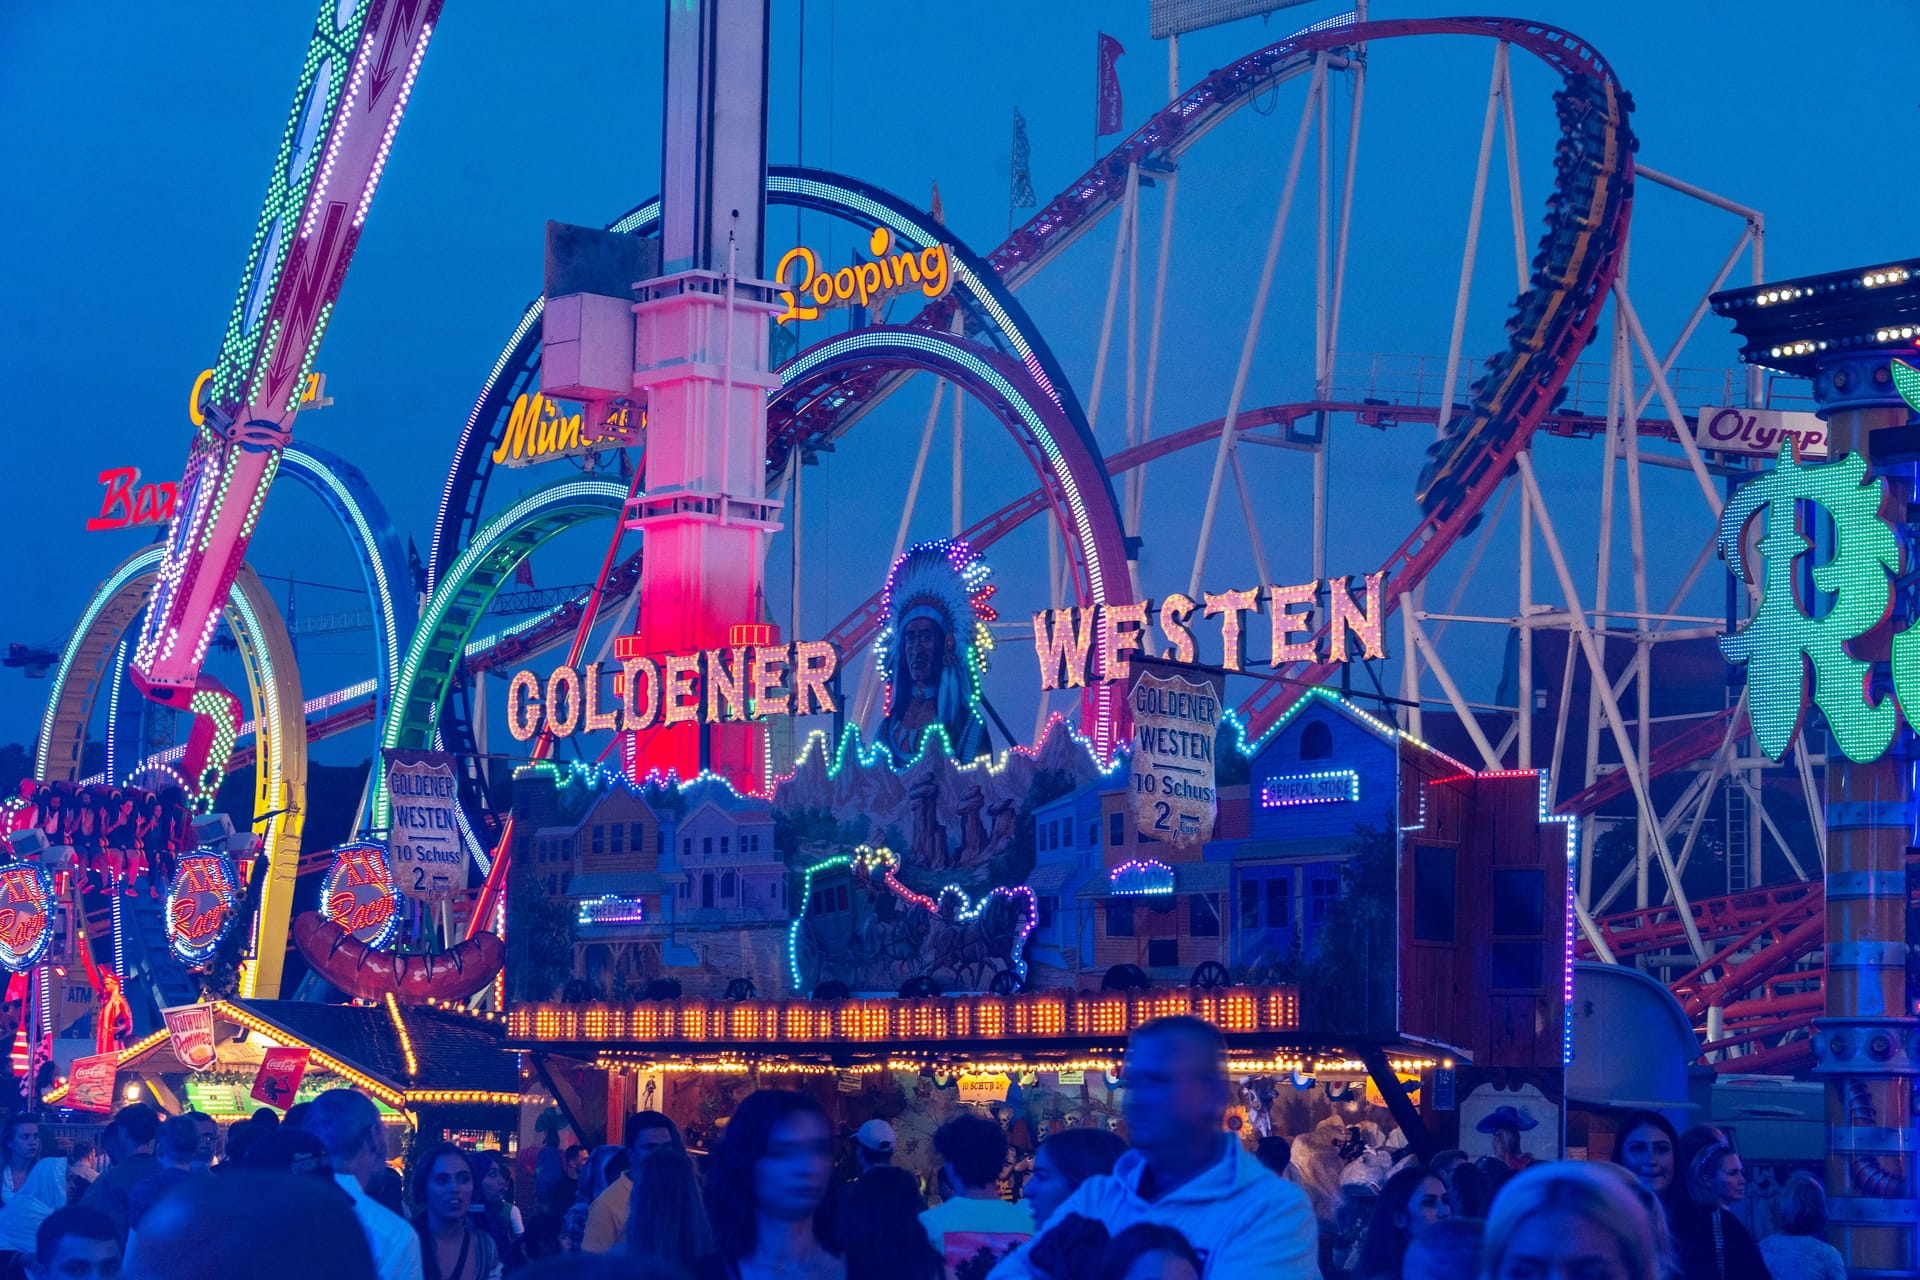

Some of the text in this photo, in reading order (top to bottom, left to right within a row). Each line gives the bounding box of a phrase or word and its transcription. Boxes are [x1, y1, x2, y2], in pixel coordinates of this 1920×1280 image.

[776, 227, 948, 325] Looping
[508, 571, 1392, 741] GOLDENER WESTEN
[1136, 685, 1216, 728] GOLDENER
[1140, 726, 1211, 764] WESTEN
[391, 773, 454, 799] GOLDENER
[1134, 773, 1216, 802] 10 Schuss
[1271, 780, 1350, 799] GENERAL STORE
[397, 805, 454, 832] WESTEN
[395, 845, 462, 865] 10 Schuss
[68, 985, 92, 1002] ATM
[174, 1031, 212, 1054] Pommes
